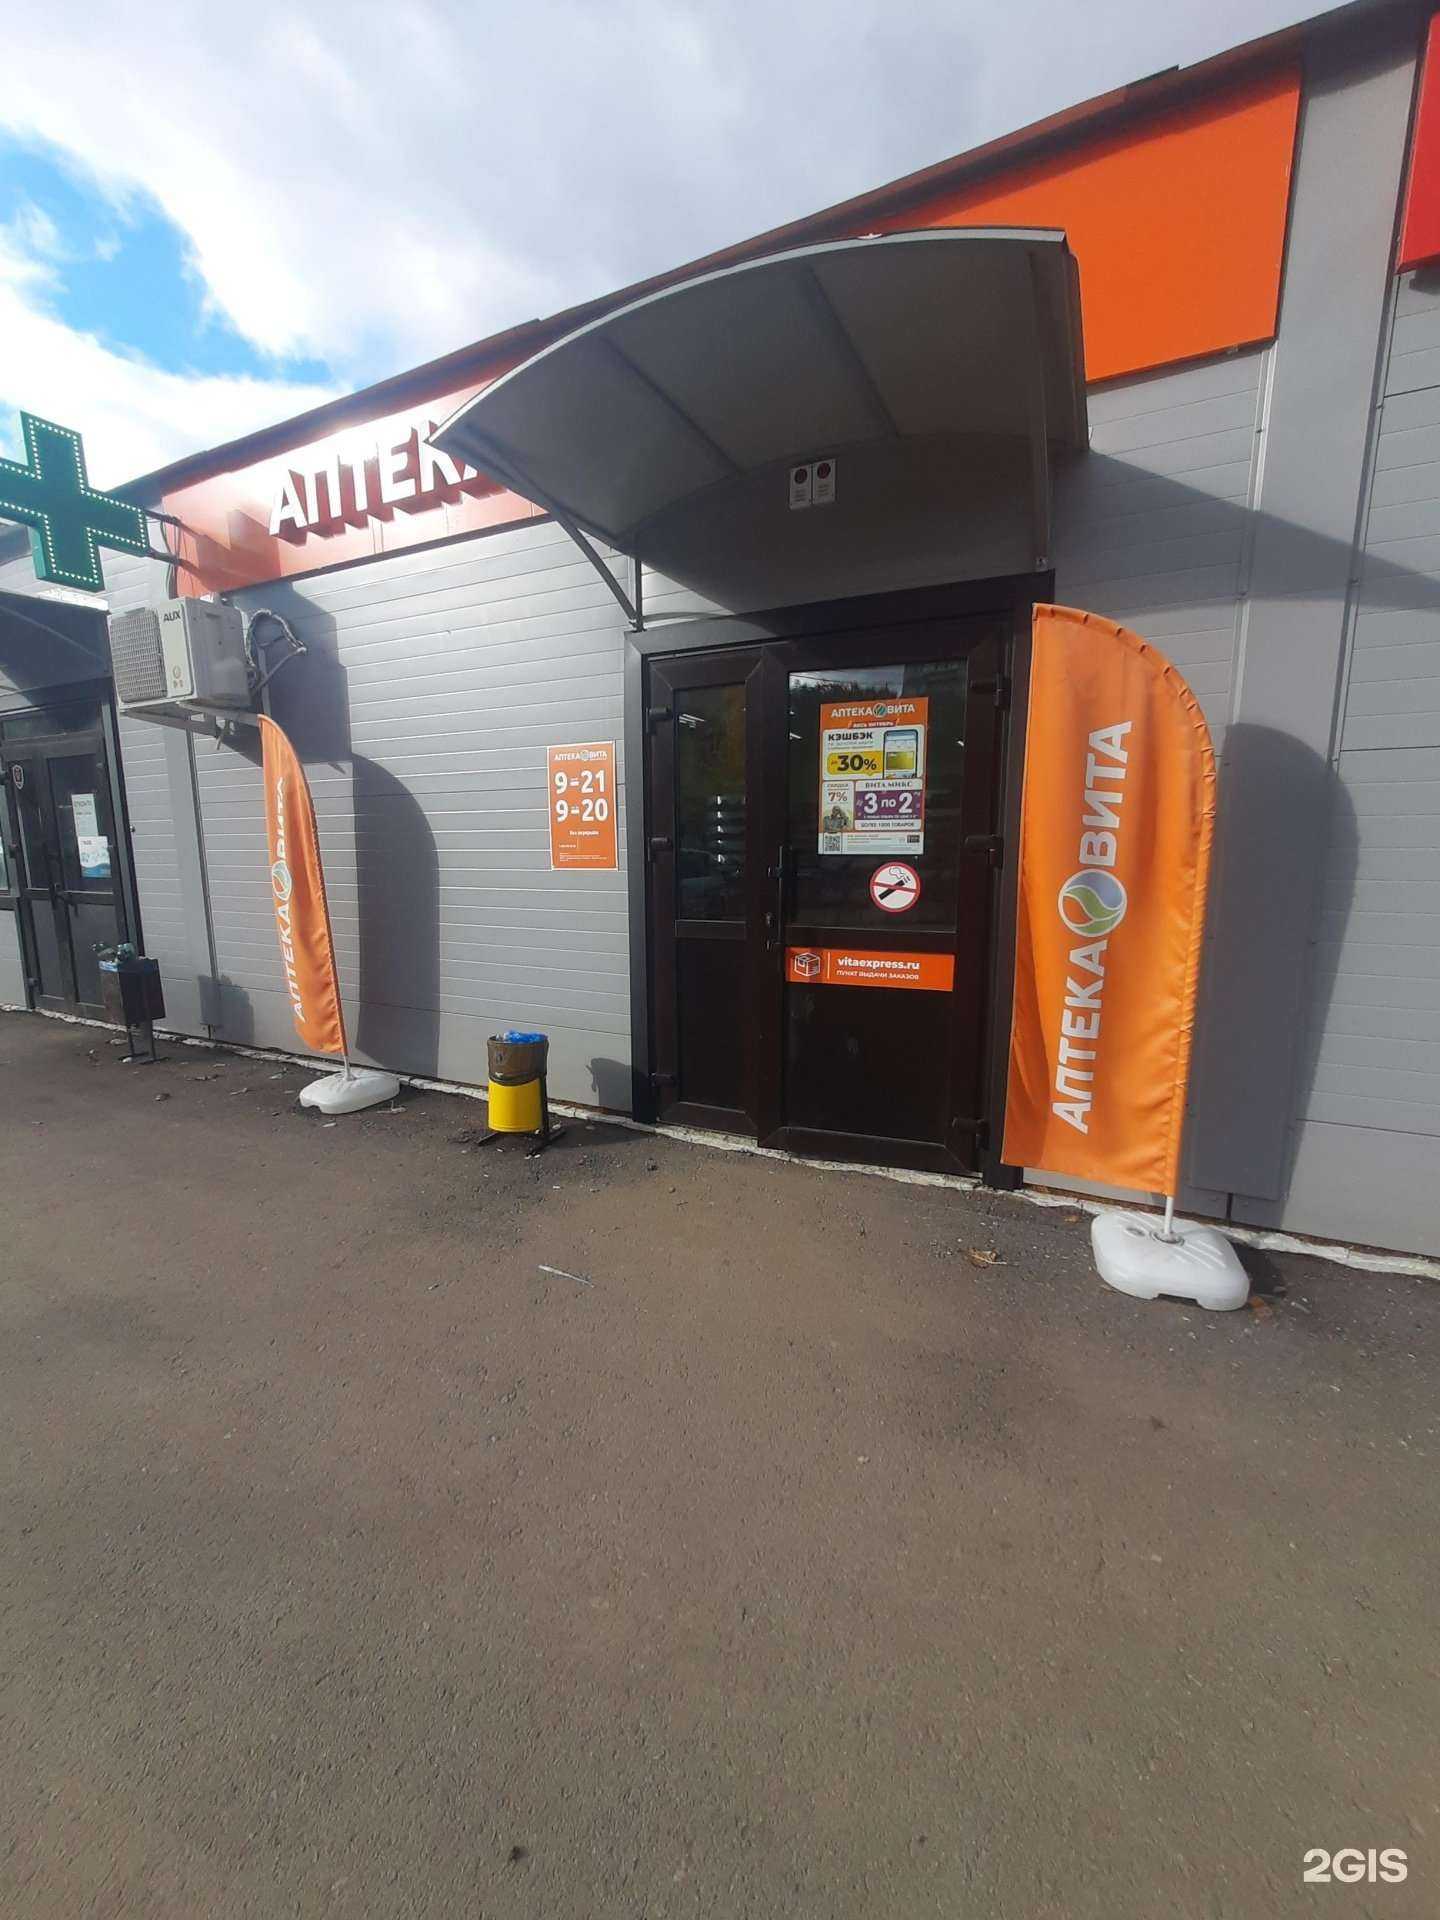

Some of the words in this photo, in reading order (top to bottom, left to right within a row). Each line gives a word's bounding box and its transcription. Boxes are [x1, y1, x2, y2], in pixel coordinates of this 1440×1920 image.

[268, 419, 478, 536] АПТЕК
[163, 610, 181, 622] AUX
[831, 706, 873, 718] АПТЕКА
[887, 703, 915, 714] ВИТА
[828, 732, 873, 741] КЭШБЭК
[554, 752, 581, 761] АПТЕКА
[837, 754, 877, 771] 30%
[554, 769, 605, 794] 9-21
[828, 791, 848, 802] 7%
[1079, 720, 1132, 867] ВИТА
[555, 798, 608, 822] 9-20
[863, 792, 878, 814] 3
[881, 798, 897, 808] по
[898, 792, 913, 814] 2
[276, 901, 306, 1022] АПТЕКА
[838, 957, 920, 970] vitaexpress.ru
[836, 969, 857, 977] ПУНКТ
[888, 972, 919, 980] ЗАКАЗОВ
[1052, 938, 1107, 1135] АПТЕКА
